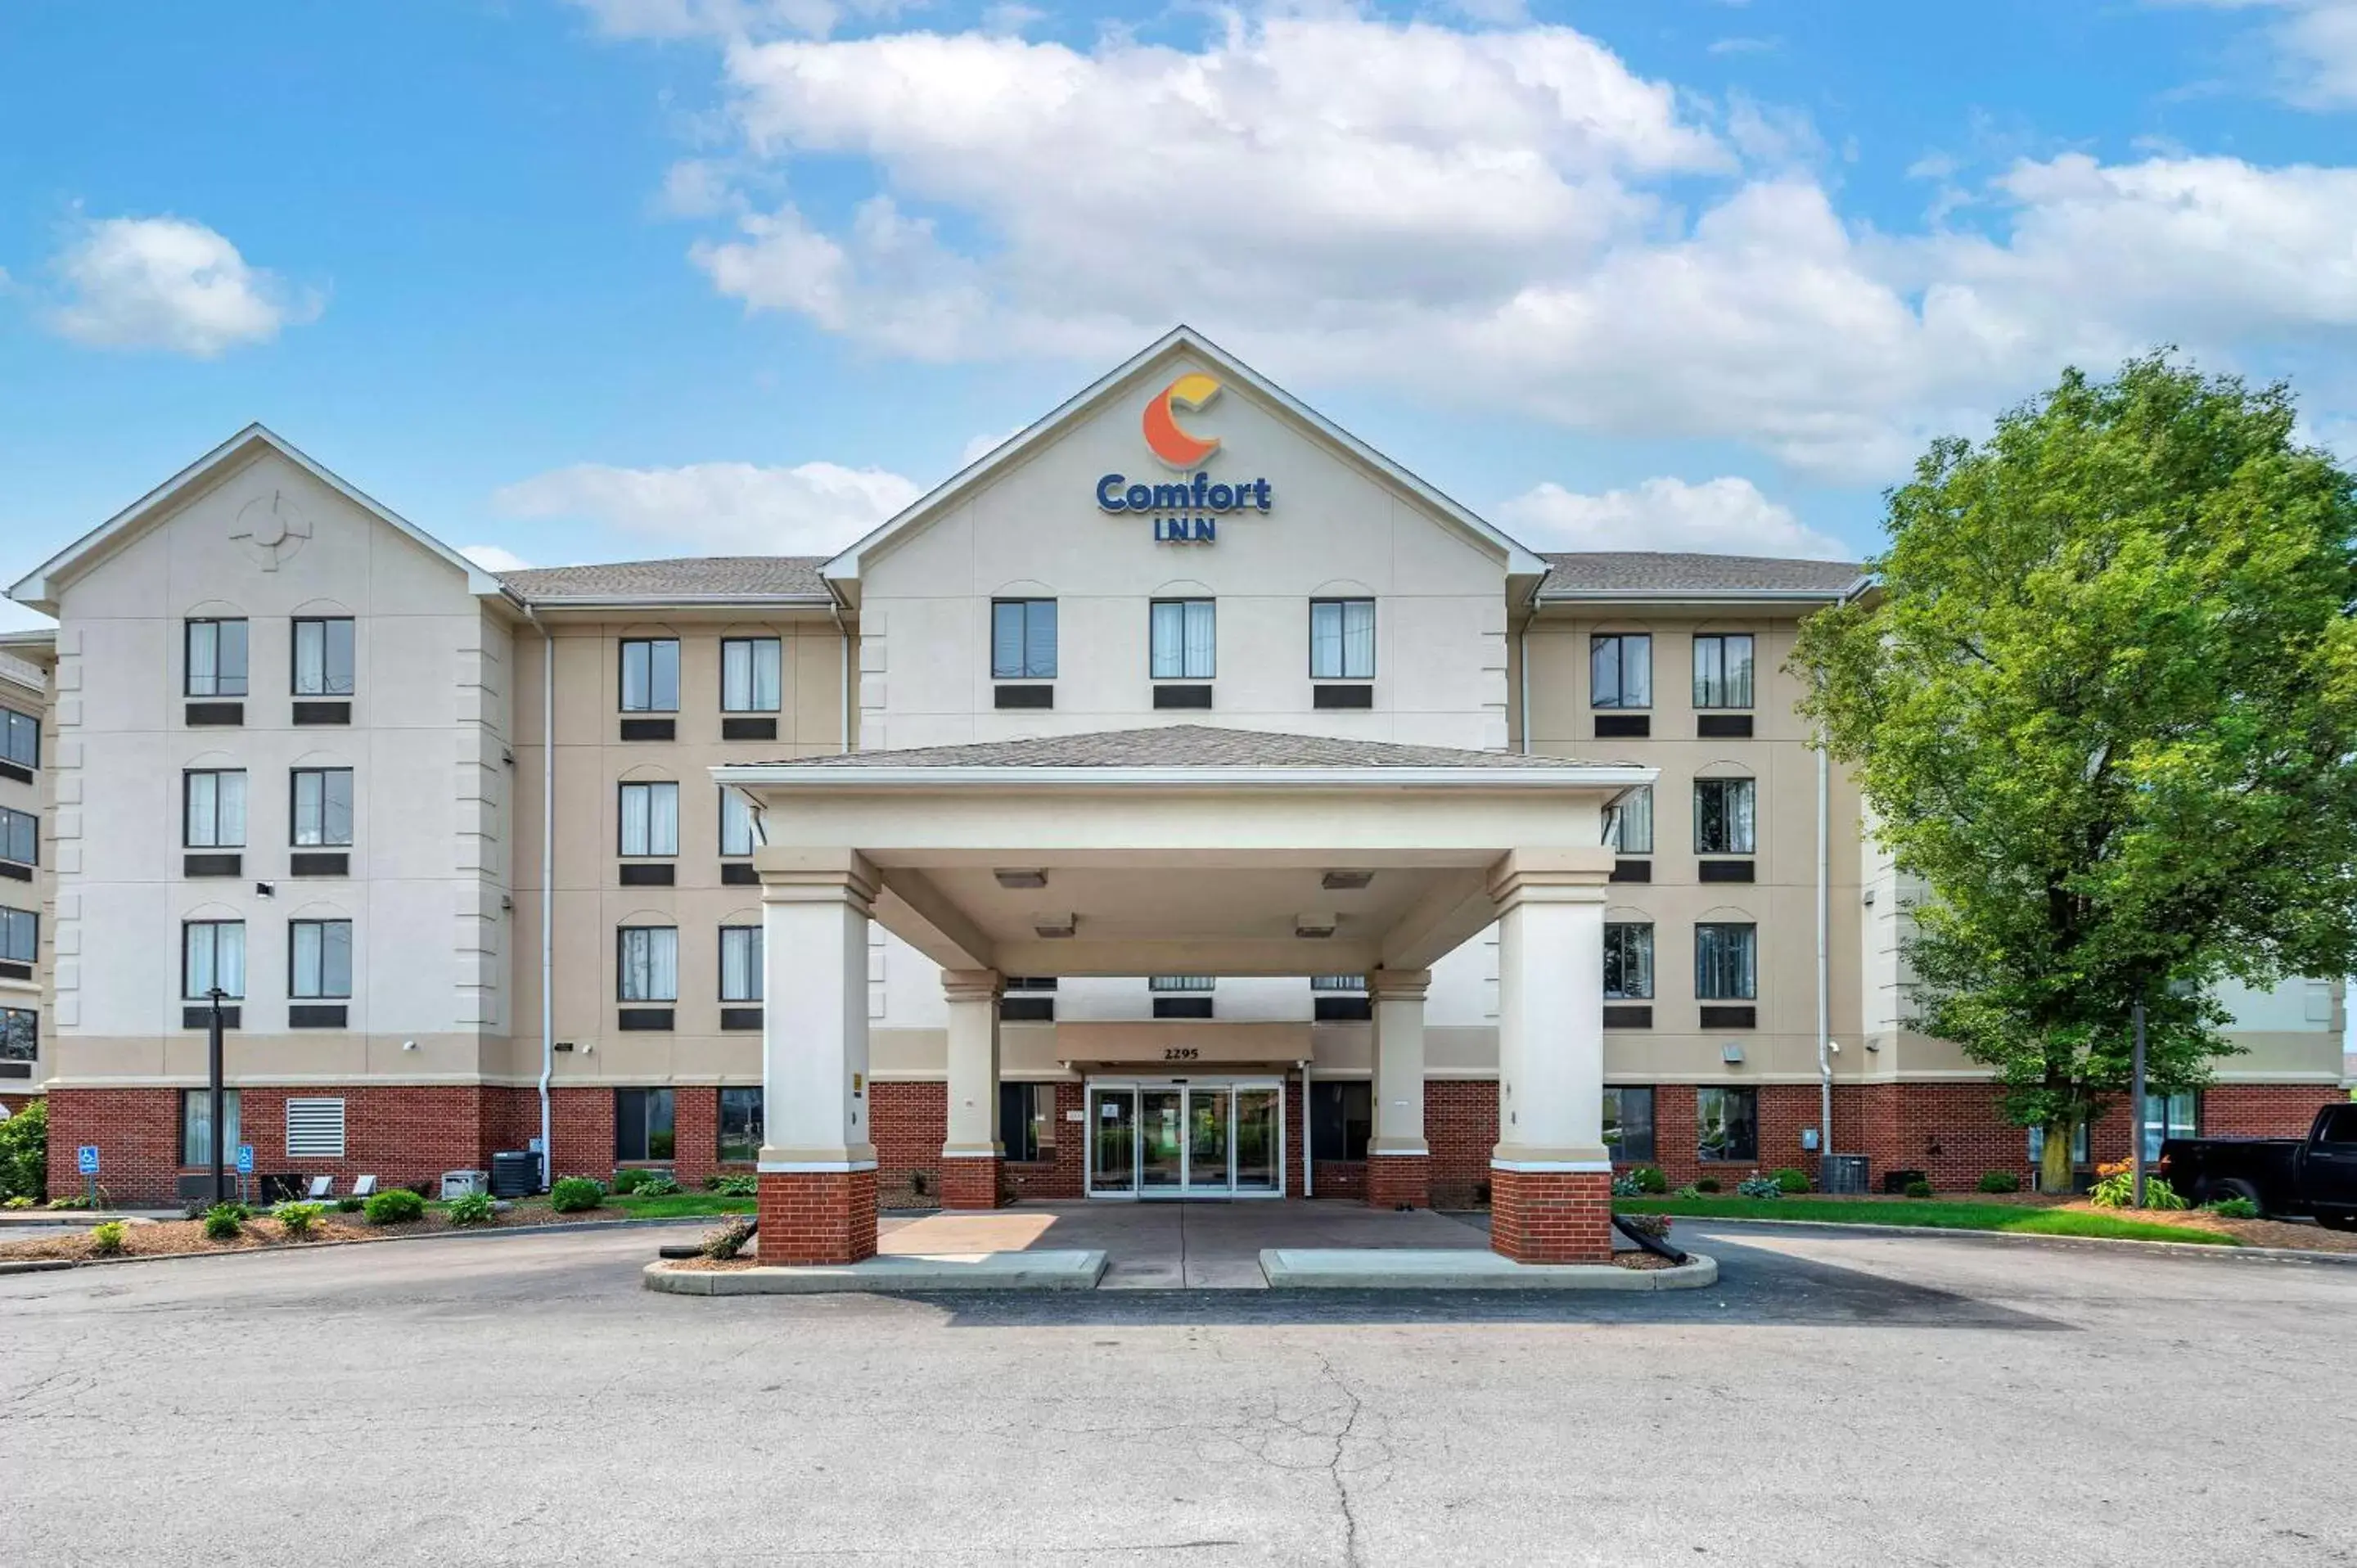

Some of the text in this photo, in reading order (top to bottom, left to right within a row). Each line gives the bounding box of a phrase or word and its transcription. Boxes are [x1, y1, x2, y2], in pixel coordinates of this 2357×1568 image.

[1097, 472, 1271, 511] Comfort
[1155, 518, 1215, 542] INN
[1165, 1048, 1198, 1059] 2295
